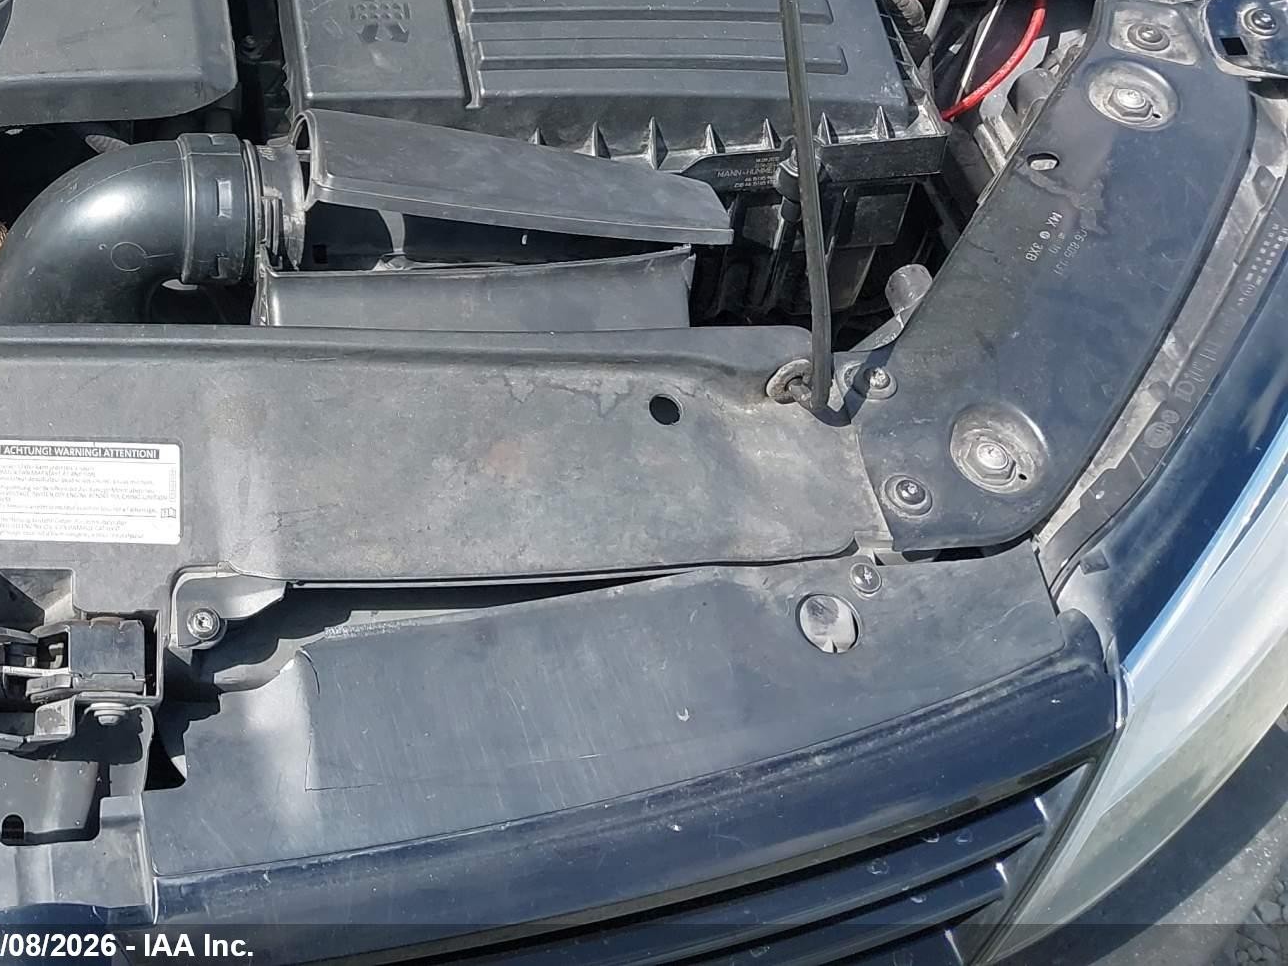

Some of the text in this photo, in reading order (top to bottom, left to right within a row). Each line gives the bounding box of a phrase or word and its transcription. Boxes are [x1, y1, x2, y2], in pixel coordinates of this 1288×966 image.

[3, 445, 157, 459] ACHTUNG! WARNING! ATTENTION!
